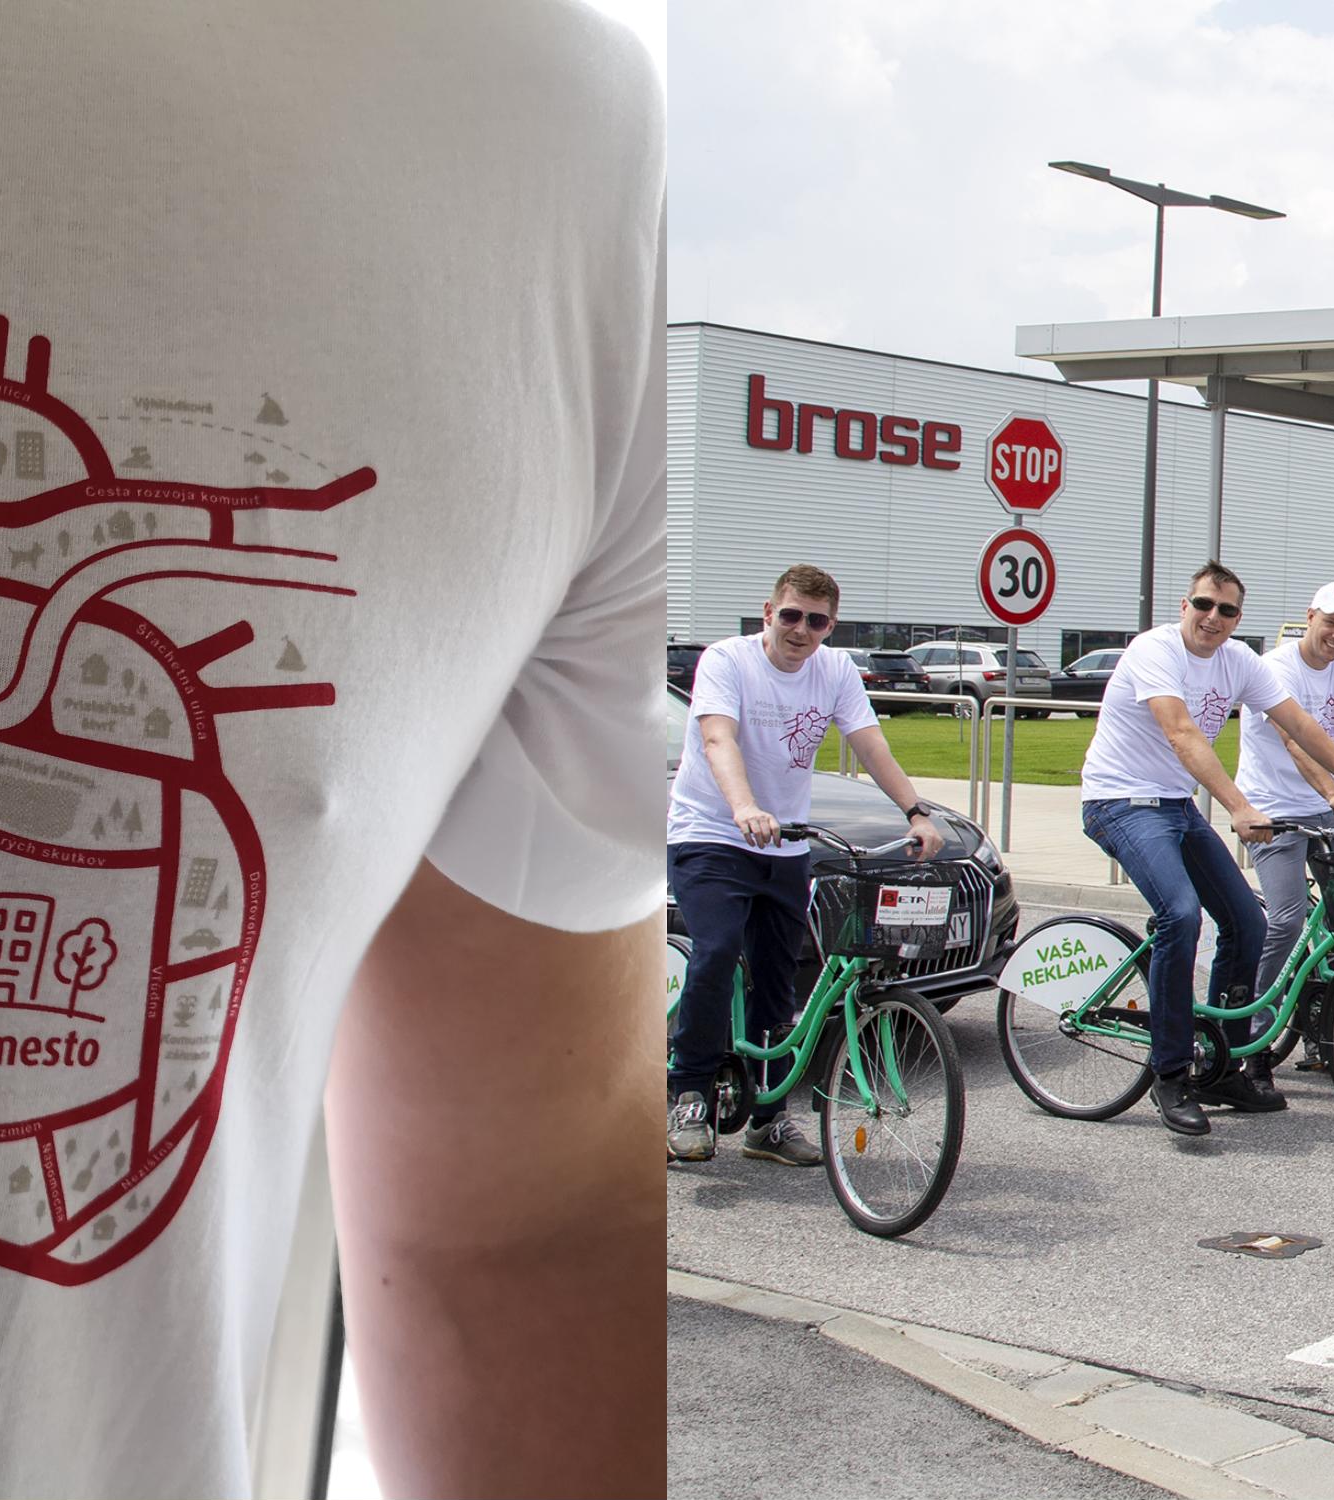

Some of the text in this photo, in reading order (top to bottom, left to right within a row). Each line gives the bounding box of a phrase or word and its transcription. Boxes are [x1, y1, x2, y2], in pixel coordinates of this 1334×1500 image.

[747, 373, 962, 470] brose
[994, 443, 1059, 484] STOP
[85, 485, 131, 498] Cesta
[137, 486, 196, 503] rozvoja
[997, 554, 1043, 600] 30
[190, 699, 207, 742] ulica
[41, 848, 107, 867] skutkov
[880, 891, 927, 906] BETA
[1036, 937, 1087, 963] VAŠA
[1022, 953, 1108, 987] REKLAMA
